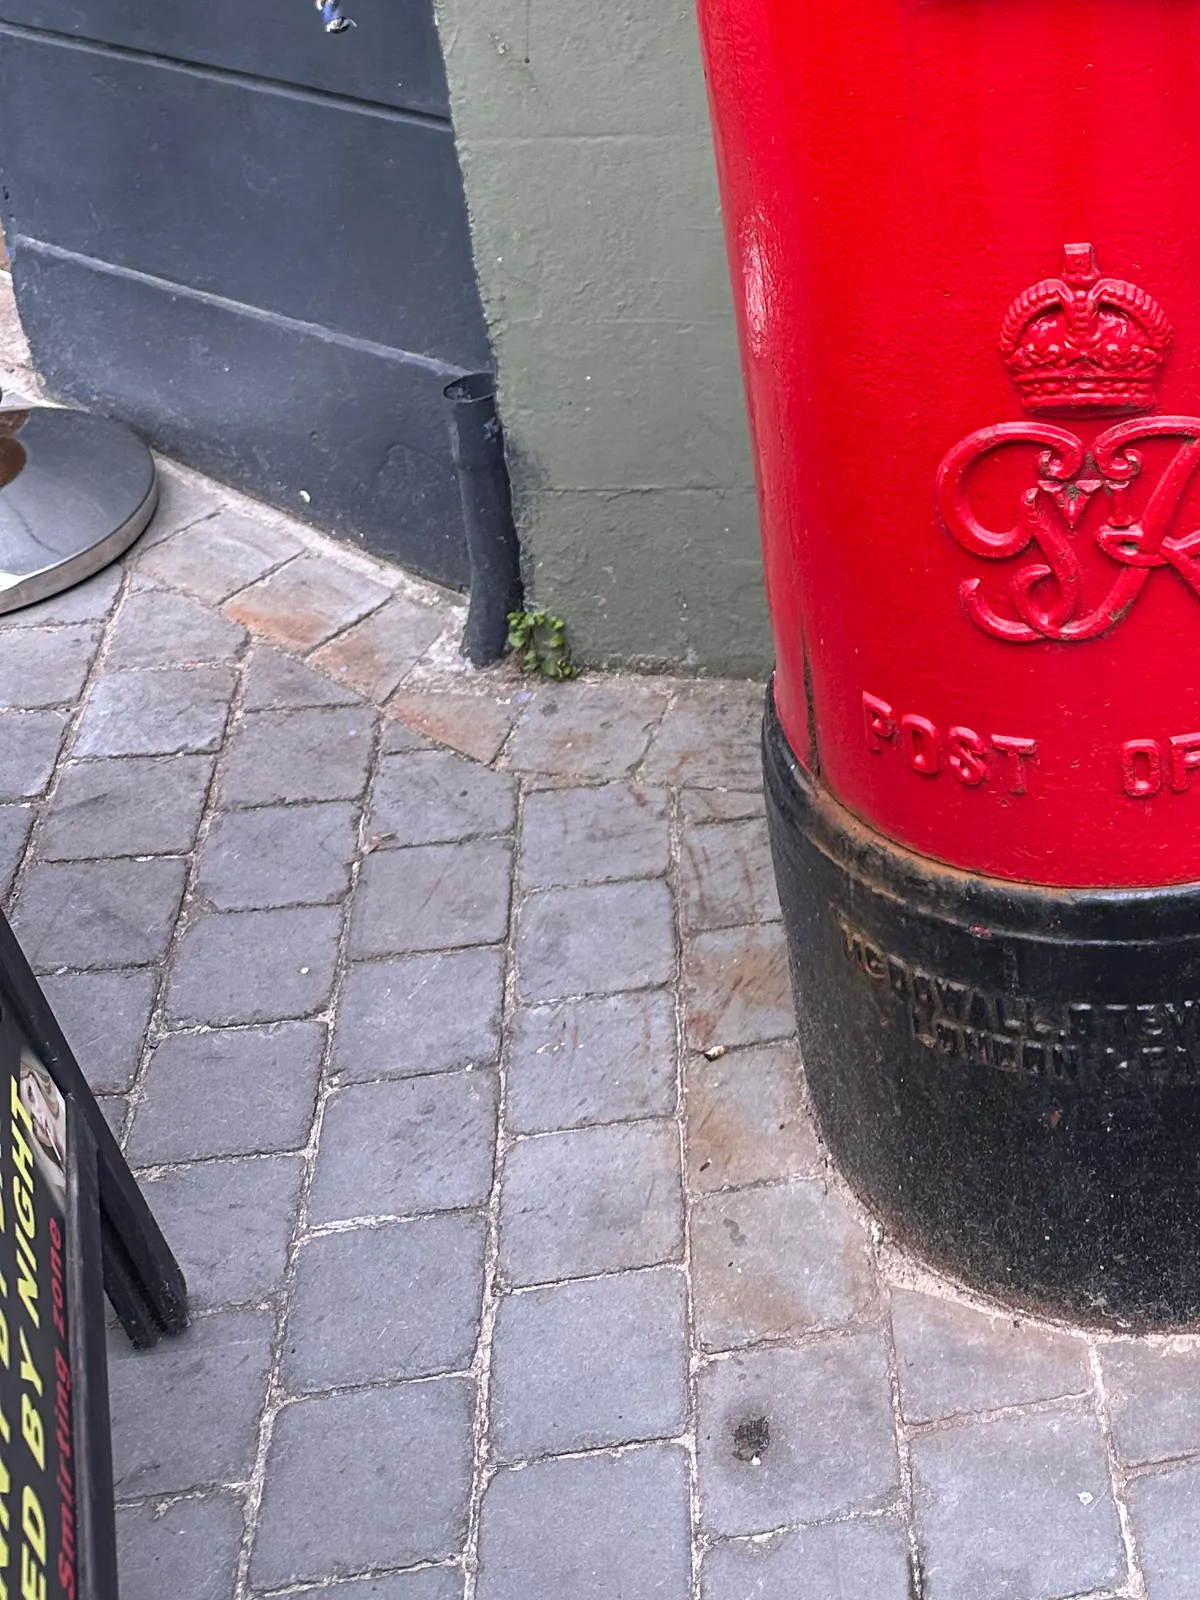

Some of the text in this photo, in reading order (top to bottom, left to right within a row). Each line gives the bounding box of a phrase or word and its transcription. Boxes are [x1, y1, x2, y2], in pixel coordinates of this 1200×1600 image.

[862, 690, 1036, 795] POST
[11, 1075, 40, 1330] NIGHT
[50, 1217, 66, 1340] zone
[19, 1325, 45, 1472] BY
